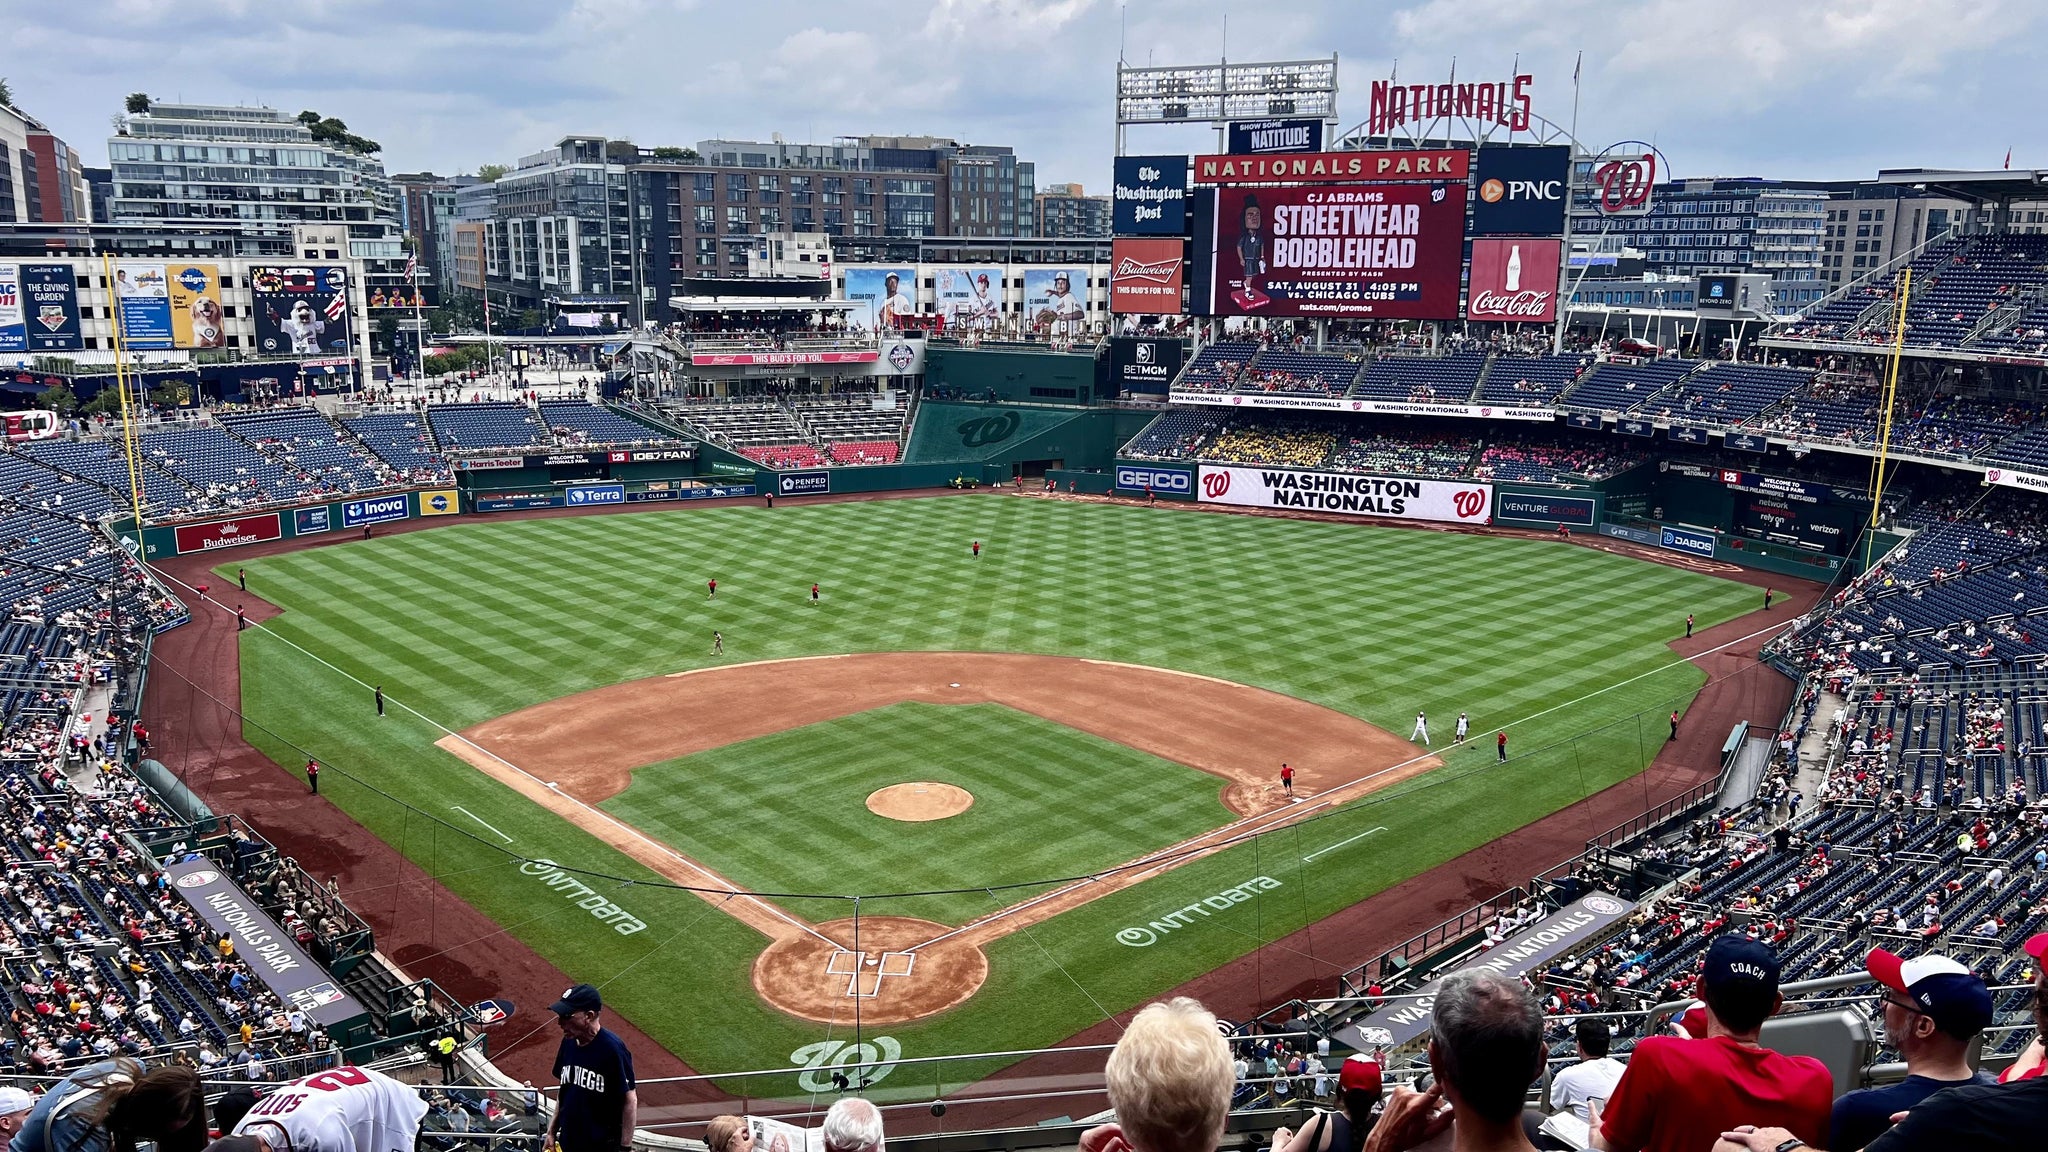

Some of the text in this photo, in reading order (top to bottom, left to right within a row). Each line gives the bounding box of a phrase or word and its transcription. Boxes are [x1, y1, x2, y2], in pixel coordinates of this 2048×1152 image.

[1370, 75, 1532, 135] NATIONALS
[1262, 122, 1282, 130] SOME
[1251, 126, 1310, 149] NATITUDE
[1138, 166, 1160, 181] The
[1204, 156, 1453, 177] NATIONALS PARK
[1116, 186, 1182, 202] Washington
[1508, 180, 1562, 200] PNC
[1307, 192, 1384, 203] CJ ABRAMS
[1134, 206, 1162, 222] Post
[1274, 204, 1420, 236] STREETWEAR
[1273, 238, 1416, 269] BOBBLEHEAD
[1118, 263, 1174, 276] Budweiser
[173, 274, 211, 284] Pedigree
[27, 284, 69, 292] THE GIVING
[1268, 282, 1418, 292] SAT, AUGUST 31 4:05 PM
[34, 293, 64, 301] GARDEN
[1308, 291, 1360, 300] CHICAGO
[1364, 292, 1395, 300] CUBS
[1299, 304, 1372, 312] nats.com/promos
[752, 355, 768, 363] THIS
[1124, 365, 1167, 375] BETMGM
[1426, 406, 1469, 414] NATIONALS
[664, 450, 691, 459] FAN
[1119, 470, 1188, 489] GEICO
[1262, 472, 1420, 498] WASHINGTON
[1764, 478, 1791, 486] WELCOME
[1760, 482, 1789, 492] NATIONALS
[586, 490, 620, 501] Terra
[1274, 490, 1405, 514] NATIONALS
[365, 500, 402, 515] Inova
[1504, 503, 1587, 517] VENTURE GLOBAL
[1759, 499, 1788, 510] network
[1810, 523, 1839, 535] verizon
[1674, 536, 1712, 550] DABOS
[205, 892, 301, 973] NATIONALS PARK
[1502, 912, 1595, 962] NATIONALS
[1730, 962, 1766, 980] COACH
[574, 1066, 604, 1092] DIEGO
